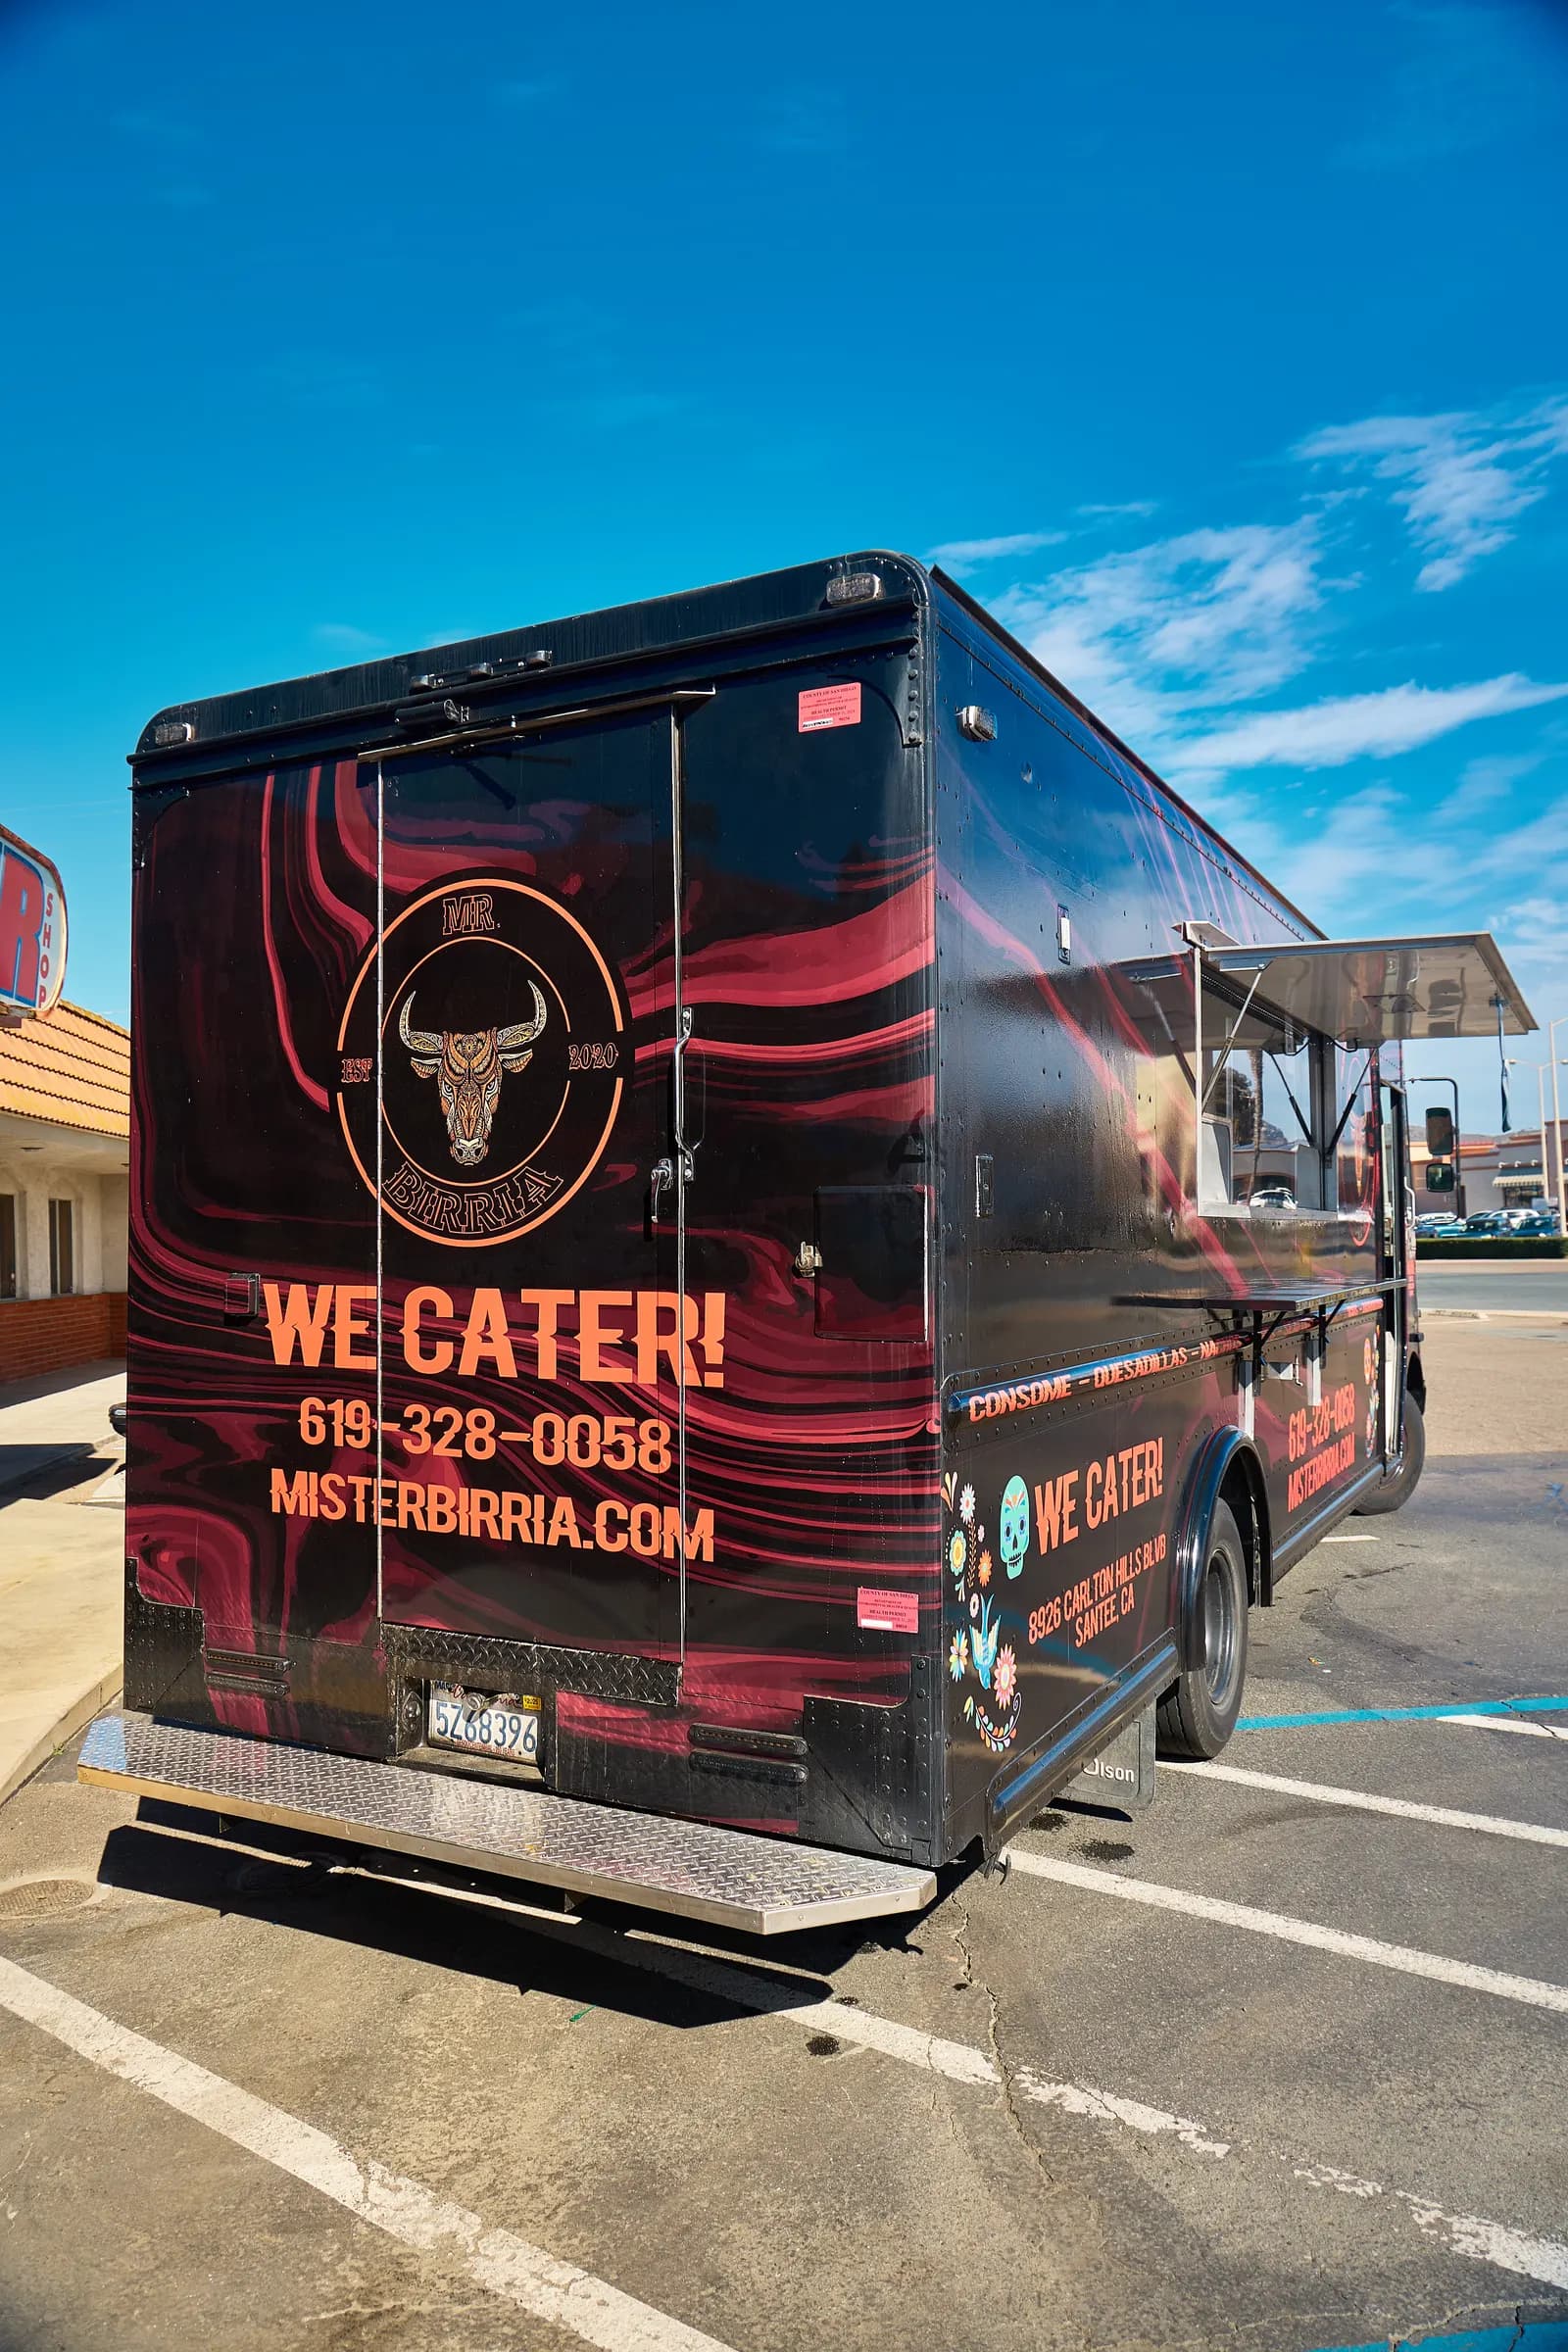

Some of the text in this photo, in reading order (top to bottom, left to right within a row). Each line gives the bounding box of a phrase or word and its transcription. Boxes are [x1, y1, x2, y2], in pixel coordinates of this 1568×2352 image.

[0, 840, 44, 1008] R
[38, 893, 54, 1009] SHOP
[340, 1057, 372, 1083] EST
[568, 1042, 619, 1071] 2020
[382, 1160, 564, 1235] BIRRIA
[263, 1283, 726, 1389] WE CATER!
[298, 1396, 672, 1474] 619-328-0058
[968, 1374, 1073, 1422] CONSOME
[269, 1467, 714, 1563] MISTERBIRRIA.COM
[1034, 1436, 1163, 1556] WE CATER!
[1029, 1596, 1061, 1645] 8926
[1063, 1562, 1114, 1621] CARLTON
[1115, 1546, 1142, 1588] HILLS
[1075, 1582, 1135, 1647] SANTEE, CA
[436, 1700, 537, 1753] 5Z68396
